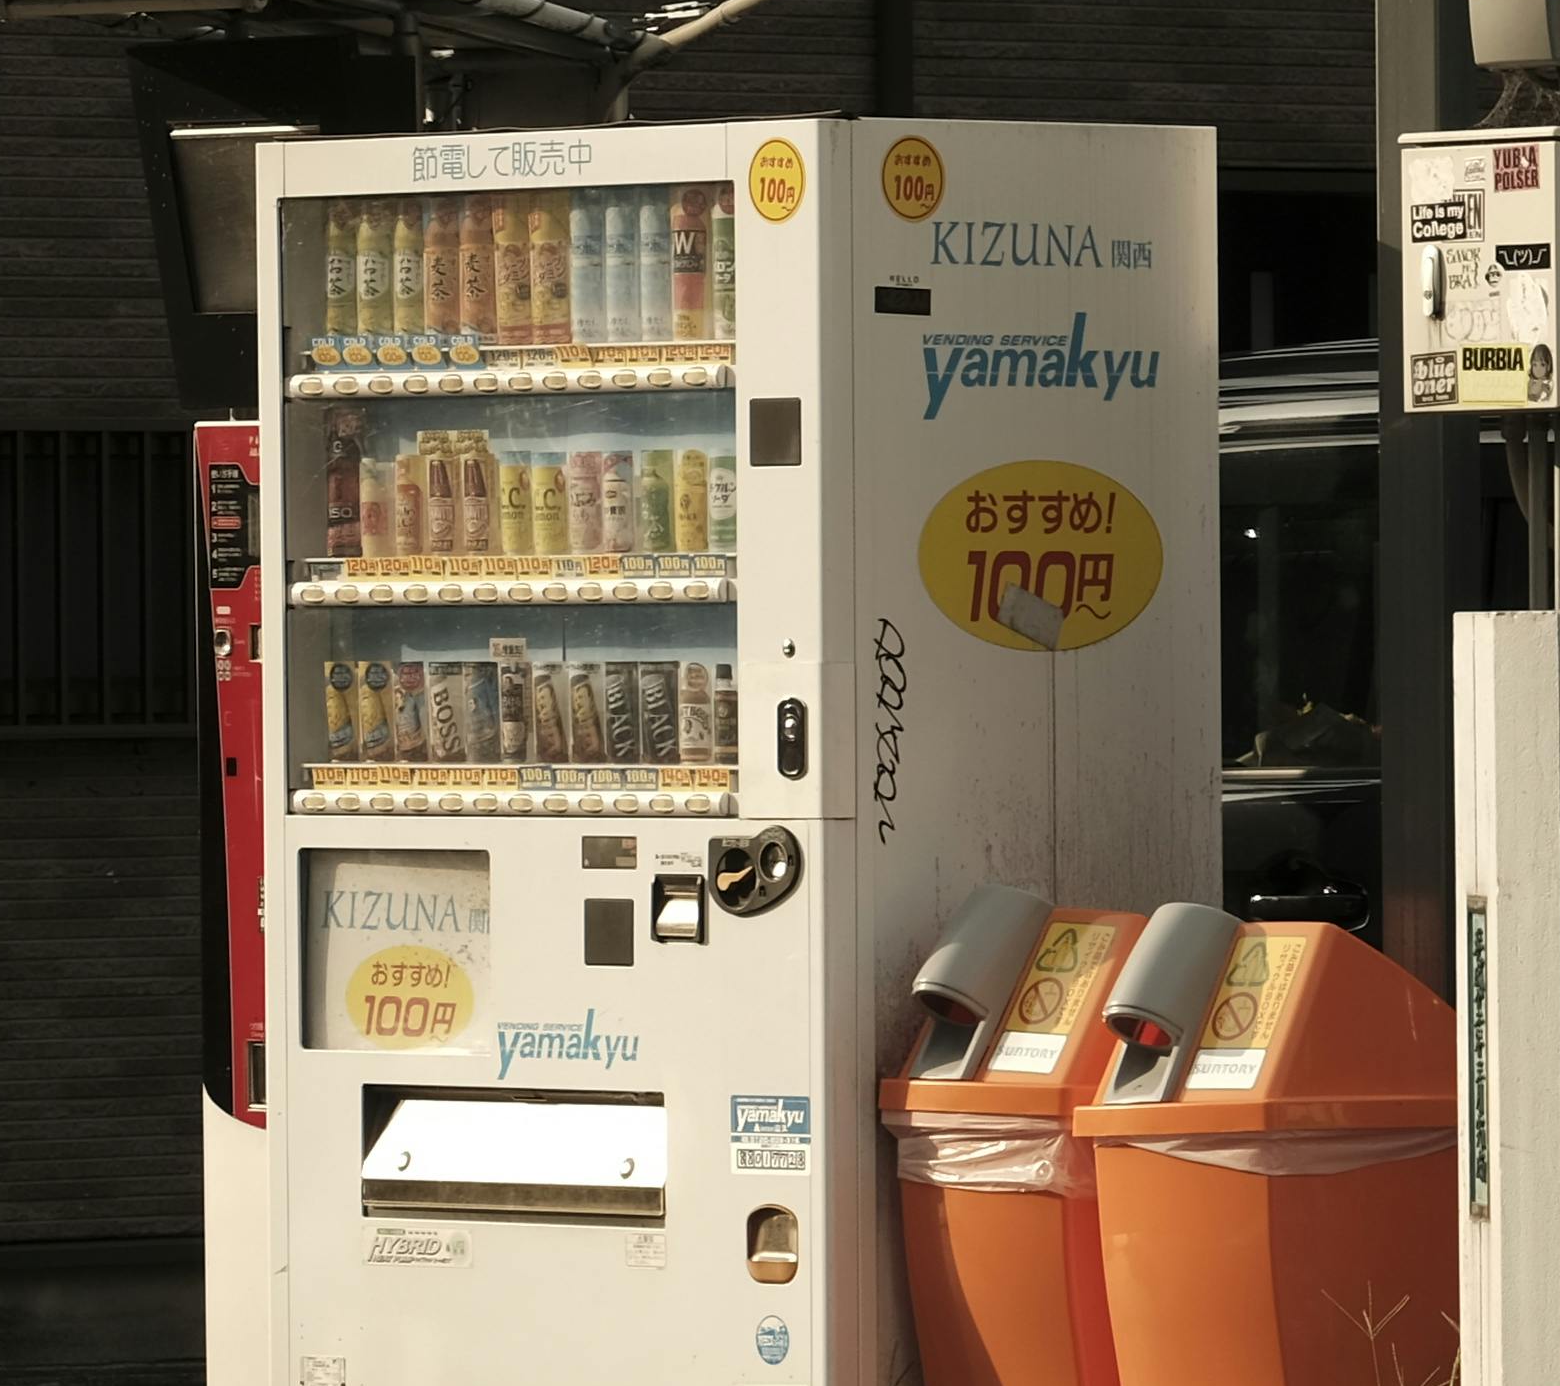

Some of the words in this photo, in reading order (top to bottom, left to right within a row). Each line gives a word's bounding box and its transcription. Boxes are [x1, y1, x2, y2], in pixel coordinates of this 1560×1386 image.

[413, 138, 592, 182] 節電して販売中
[760, 156, 793, 168] おすすめ
[894, 154, 931, 166] おすすめ
[1412, 205, 1433, 220] Life
[1435, 205, 1445, 218] is
[1447, 204, 1464, 219] my
[1413, 220, 1464, 238] College
[930, 221, 1103, 268] KIZUNA
[1111, 240, 1152, 269] 関西
[922, 334, 994, 346] VENDING
[1000, 335, 1069, 346] SERVICE
[922, 312, 1160, 420] yamakyu
[1462, 347, 1524, 371] BURBIA
[433, 687, 461, 754] BOSS
[606, 679, 636, 758] BLACK
[644, 679, 677, 758] BLACK
[321, 890, 462, 933] KIZUNA
[468, 908, 490, 934] 関
[497, 1022, 539, 1031] VENDING
[542, 1023, 583, 1031] SERVICE
[497, 1008, 639, 1080] yamakyu
[1191, 1063, 1258, 1075] SUNTORY
[736, 1099, 805, 1132] yamakyu
[368, 1237, 441, 1262] HYBRID
